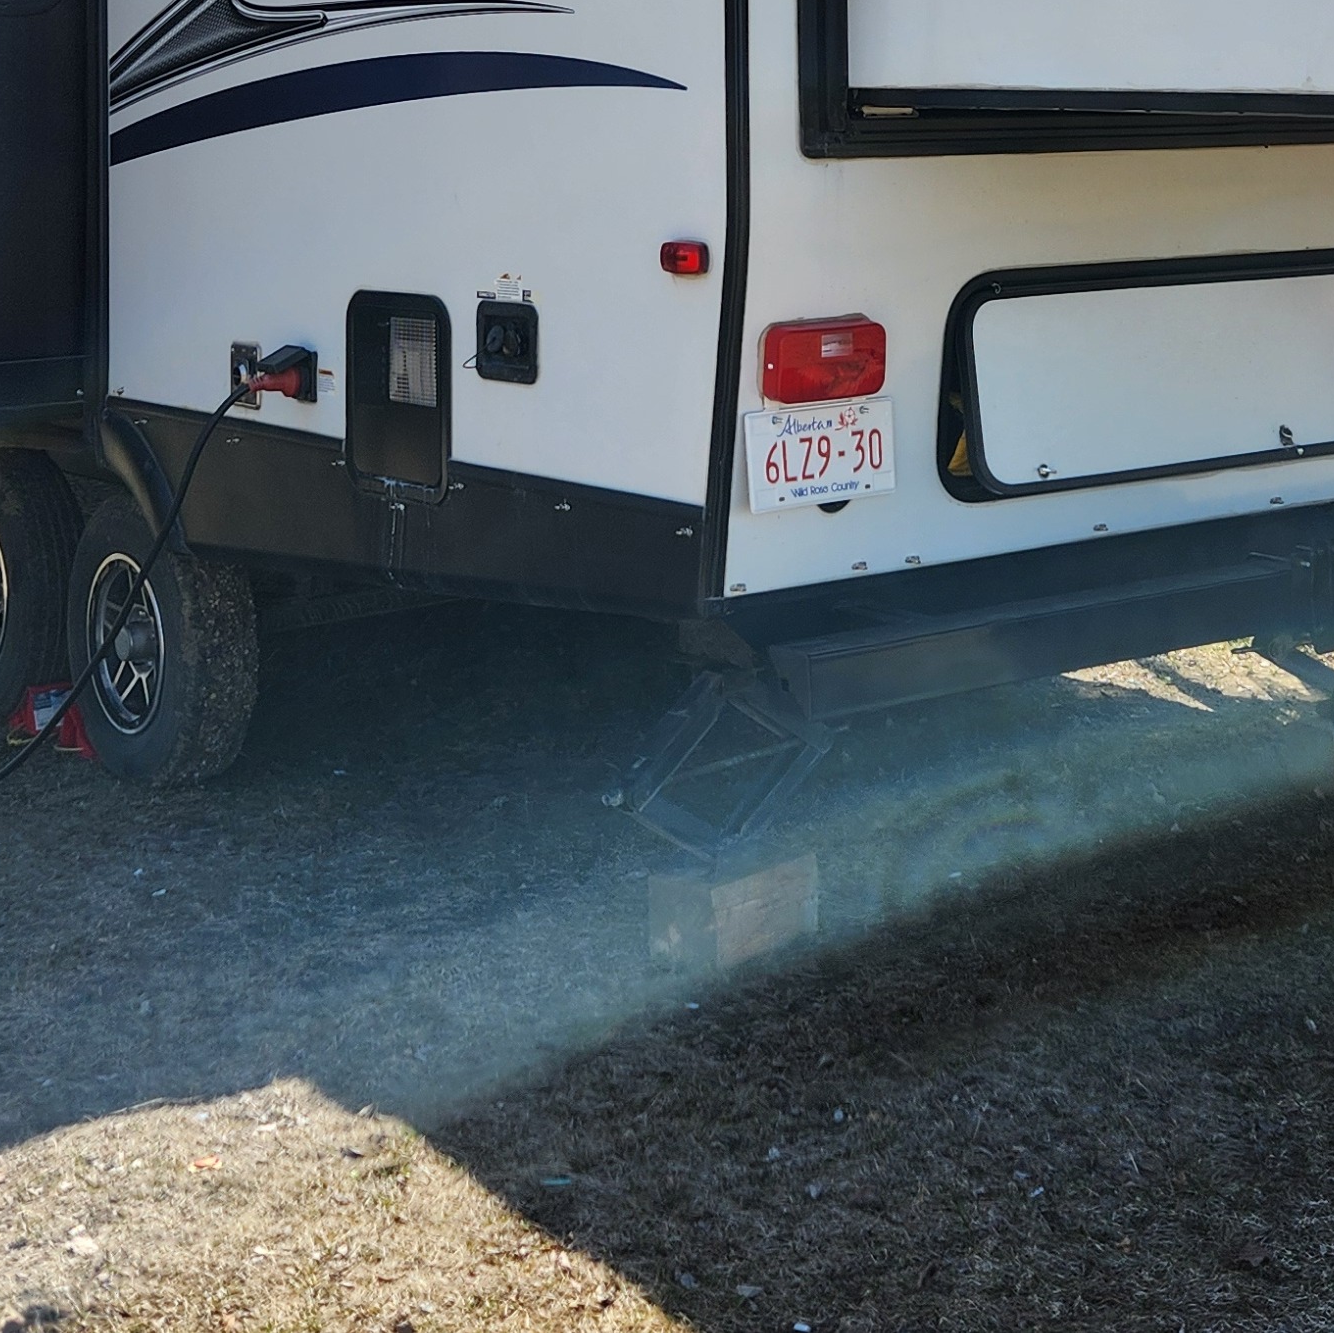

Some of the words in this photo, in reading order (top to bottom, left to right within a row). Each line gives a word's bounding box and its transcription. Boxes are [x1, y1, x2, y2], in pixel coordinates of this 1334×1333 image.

[777, 414, 829, 437] Alberta
[765, 428, 883, 484] 6LZ9-30
[790, 487, 809, 498] Wild
